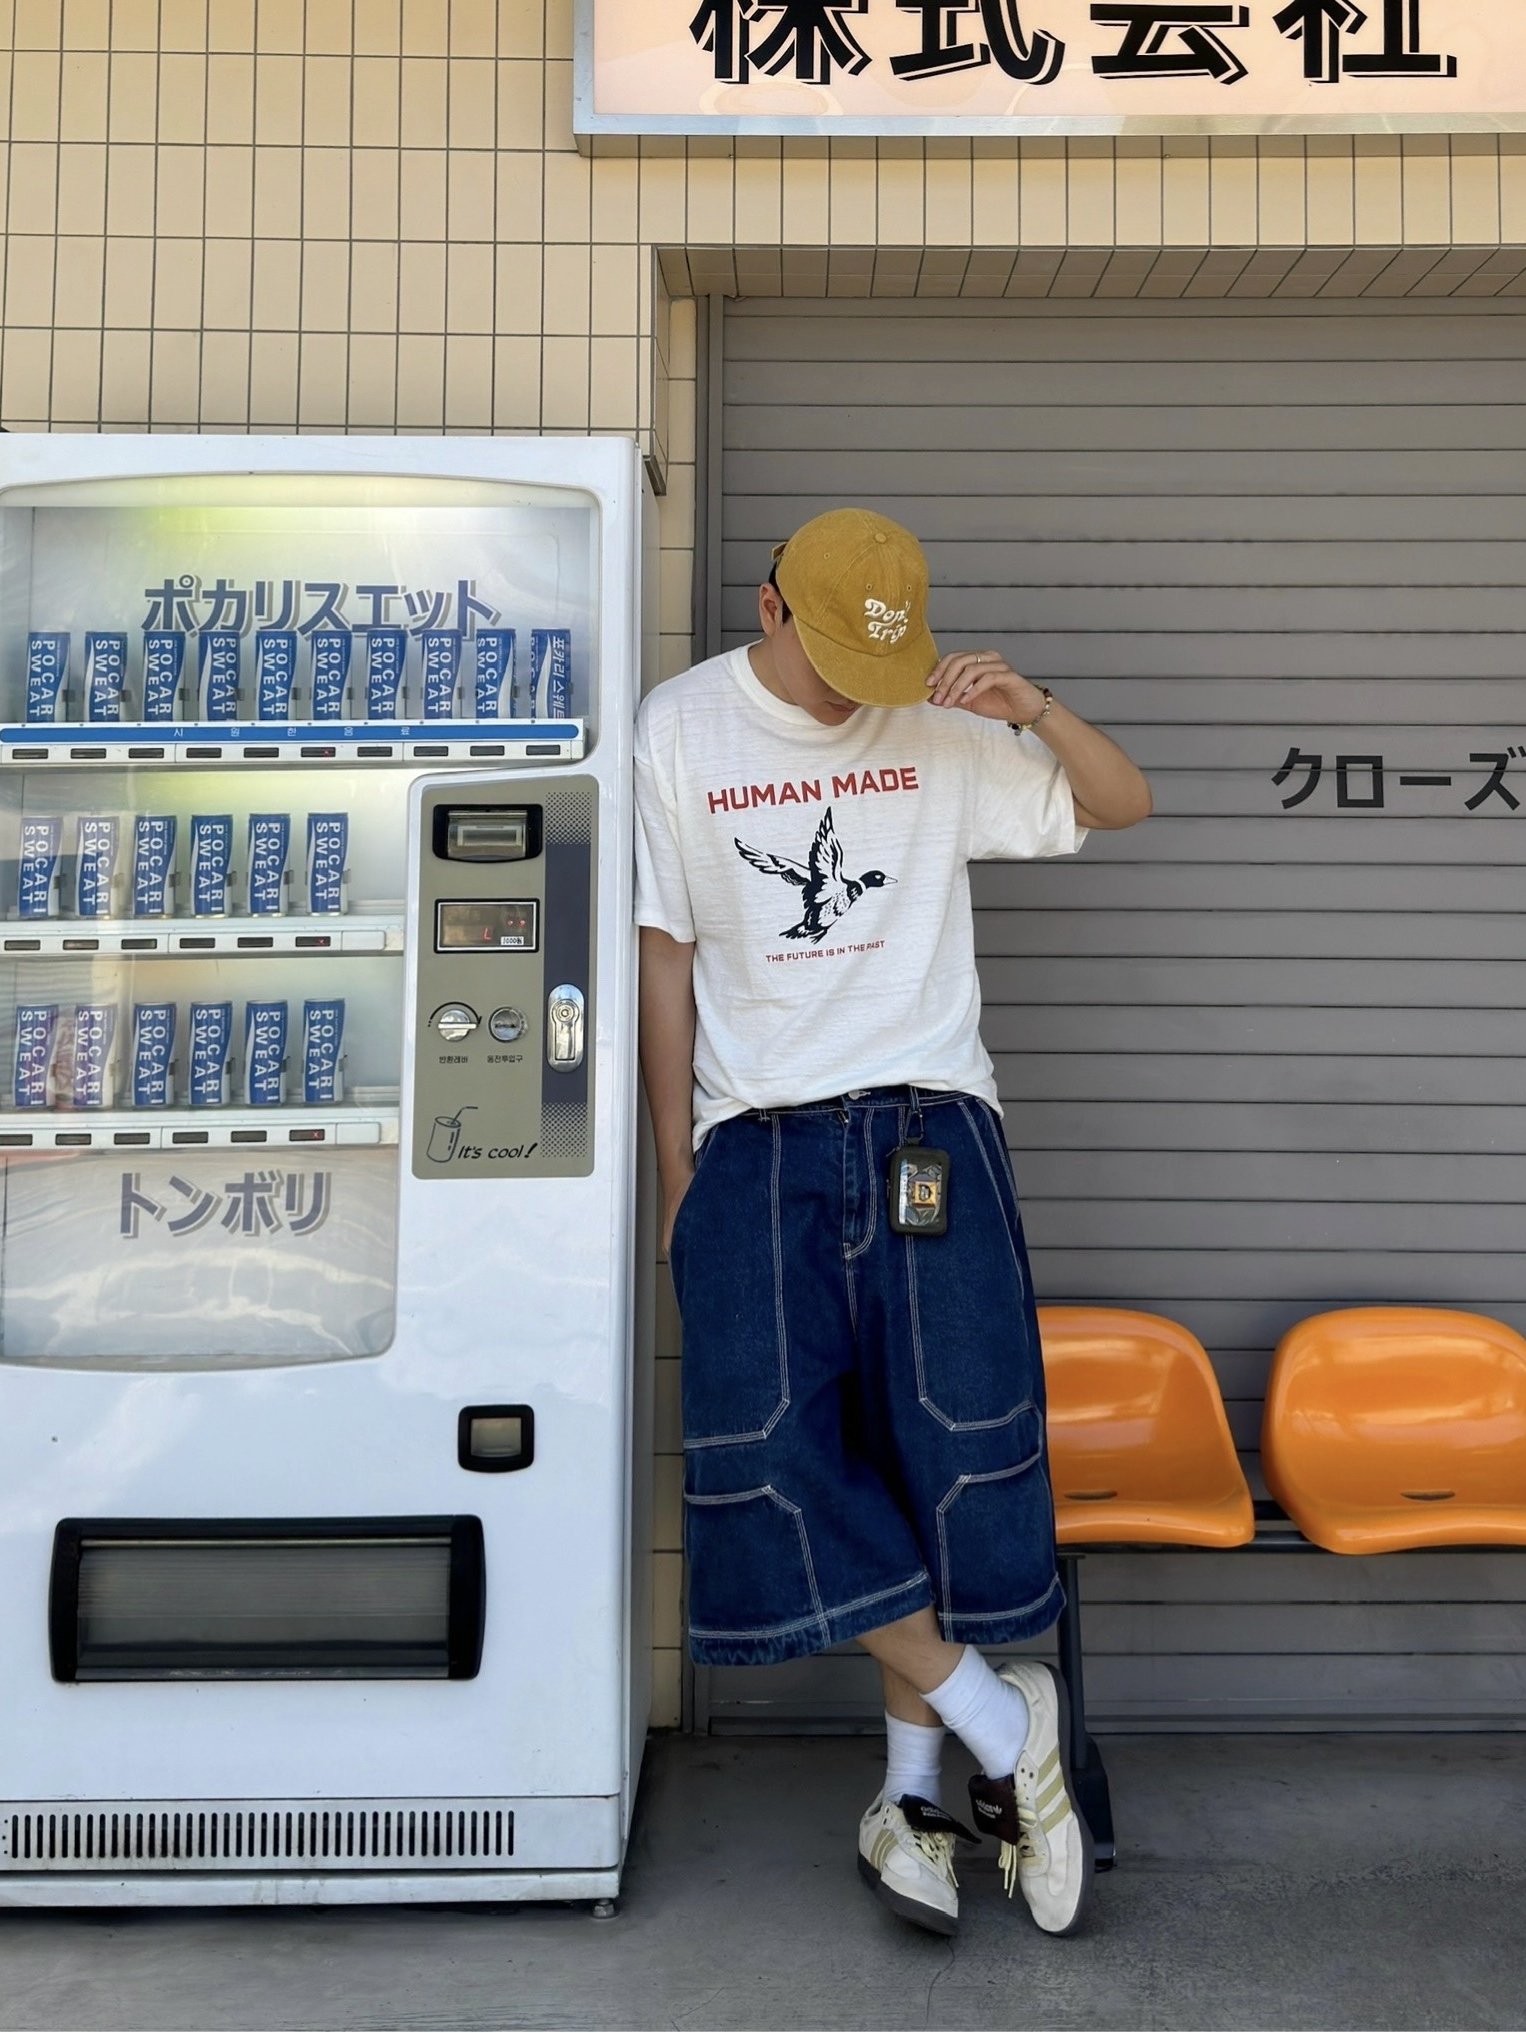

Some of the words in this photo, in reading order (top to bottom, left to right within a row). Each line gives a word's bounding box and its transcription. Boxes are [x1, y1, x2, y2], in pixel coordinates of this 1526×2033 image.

[141, 574, 501, 640] ポカリスエット
[867, 621, 907, 644] Trip
[29, 641, 42, 716] SWEAT
[41, 640, 56, 715] POCAR
[94, 640, 108, 715] SWEAT
[107, 640, 121, 715] POCAR
[147, 639, 160, 715] SWEAT
[159, 639, 174, 713] POCAR
[212, 637, 226, 713] SWEAT
[225, 638, 237, 712] POCAR
[263, 638, 276, 714] SWEAT
[276, 638, 288, 713] POCAR
[316, 638, 328, 713] SWEAT
[329, 638, 341, 712] POCAR
[371, 638, 382, 713] SWEAT
[383, 637, 395, 711] POCAR
[427, 637, 439, 712] SWEAT
[440, 637, 451, 711] POCAR
[477, 637, 486, 712] SWEAT
[485, 637, 498, 711] POCAR
[707, 779, 822, 814] HUMAN
[832, 766, 919, 798] MADE
[1271, 746, 1526, 811] クローズ
[22, 826, 36, 903] SWEAT
[33, 826, 49, 912] POCARI
[83, 822, 97, 905] SWEAT
[96, 822, 111, 914] POCARI
[137, 821, 149, 904] SWEAT
[149, 821, 164, 913] POCARI
[199, 825, 212, 902] SWEAT
[211, 824, 224, 911] POCARI
[254, 822, 268, 900] SWEAT
[266, 822, 280, 909] POCARI
[315, 822, 329, 899] SWEAT
[328, 822, 341, 909] POCARI
[766, 954, 784, 962] THE
[787, 950, 824, 960] FUTURE
[837, 947, 846, 955] IN
[848, 944, 866, 952] THE
[867, 940, 886, 950] PAST
[18, 1011, 32, 1095] SWEAT
[31, 1010, 47, 1104] POCARI
[76, 1011, 90, 1094] SWEAT
[87, 1010, 103, 1104] POCARI
[138, 1010, 152, 1094] SWEAT
[151, 1009, 166, 1103] POCARI
[194, 1009, 207, 1093] SWEAT
[206, 1008, 221, 1102] POCARI
[254, 1011, 268, 1090] SWEAT
[267, 1011, 281, 1100] POCARI
[309, 1010, 321, 1089] SWEAT
[320, 1010, 334, 1098] POCARI
[458, 1145, 482, 1159] It's
[120, 1169, 333, 1238] トンボリ
